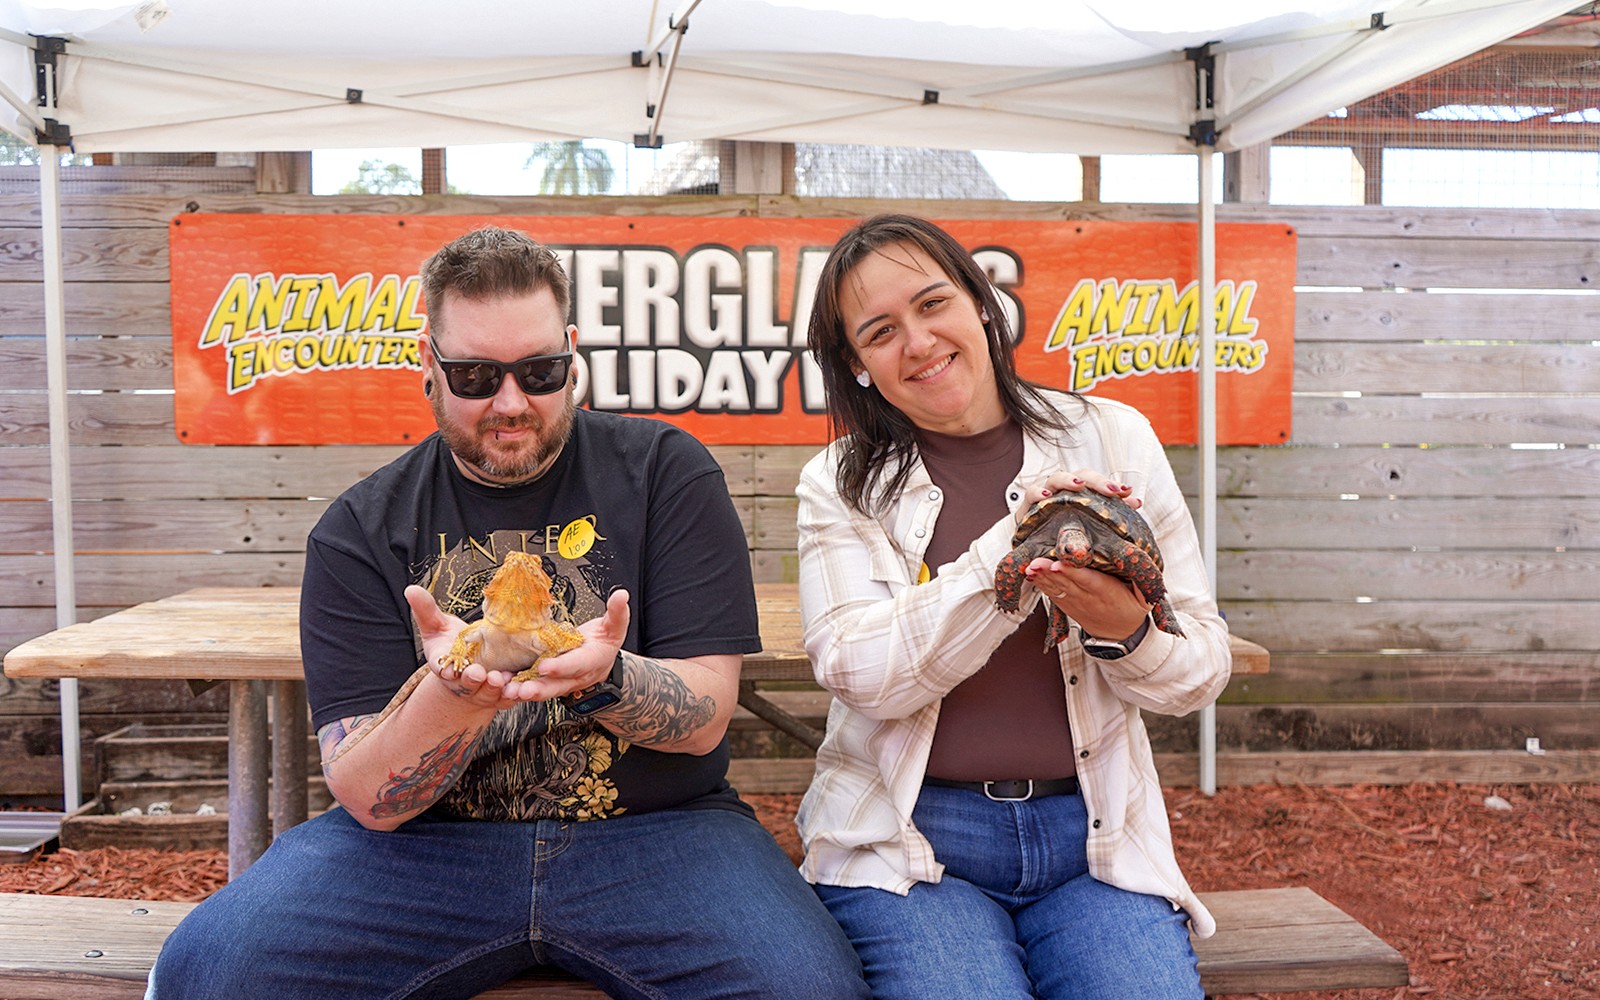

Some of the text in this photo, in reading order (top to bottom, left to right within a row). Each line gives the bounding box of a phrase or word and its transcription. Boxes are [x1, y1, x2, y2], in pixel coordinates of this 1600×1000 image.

[202, 275, 424, 345] ANIMAL
[1047, 281, 1256, 348] ANIMAL
[231, 335, 421, 389] ENCOUNTER
[573, 349, 791, 409] LIDAY
[1072, 339, 1264, 391] ENCOUNERS
[564, 522, 581, 544] AE
